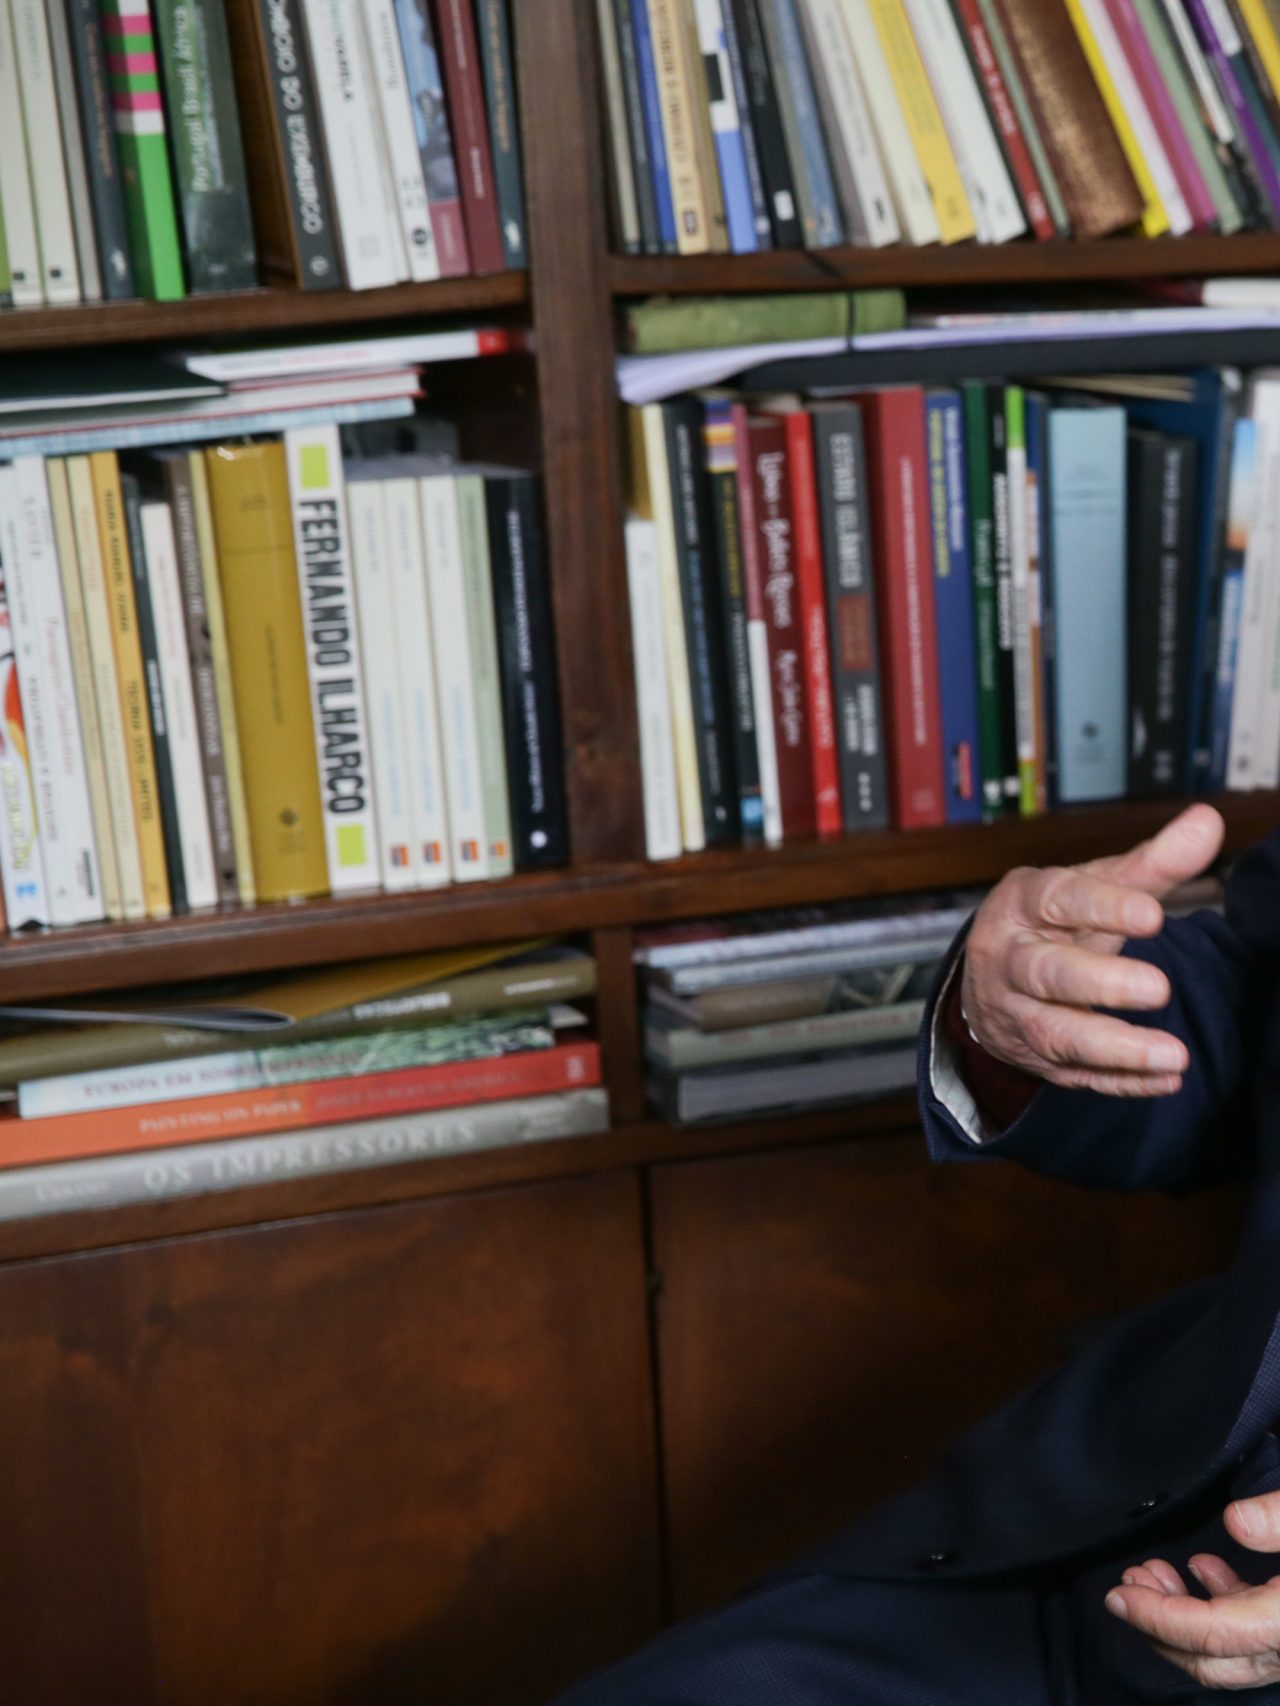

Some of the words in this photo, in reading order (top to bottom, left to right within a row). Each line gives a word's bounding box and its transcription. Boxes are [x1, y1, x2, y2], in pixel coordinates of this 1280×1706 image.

[299, 500, 353, 667] FERNANDO
[313, 676, 366, 815] ILHARCO
[143, 1161, 192, 1192] OS
[210, 1118, 477, 1181] IMPRESSORES
